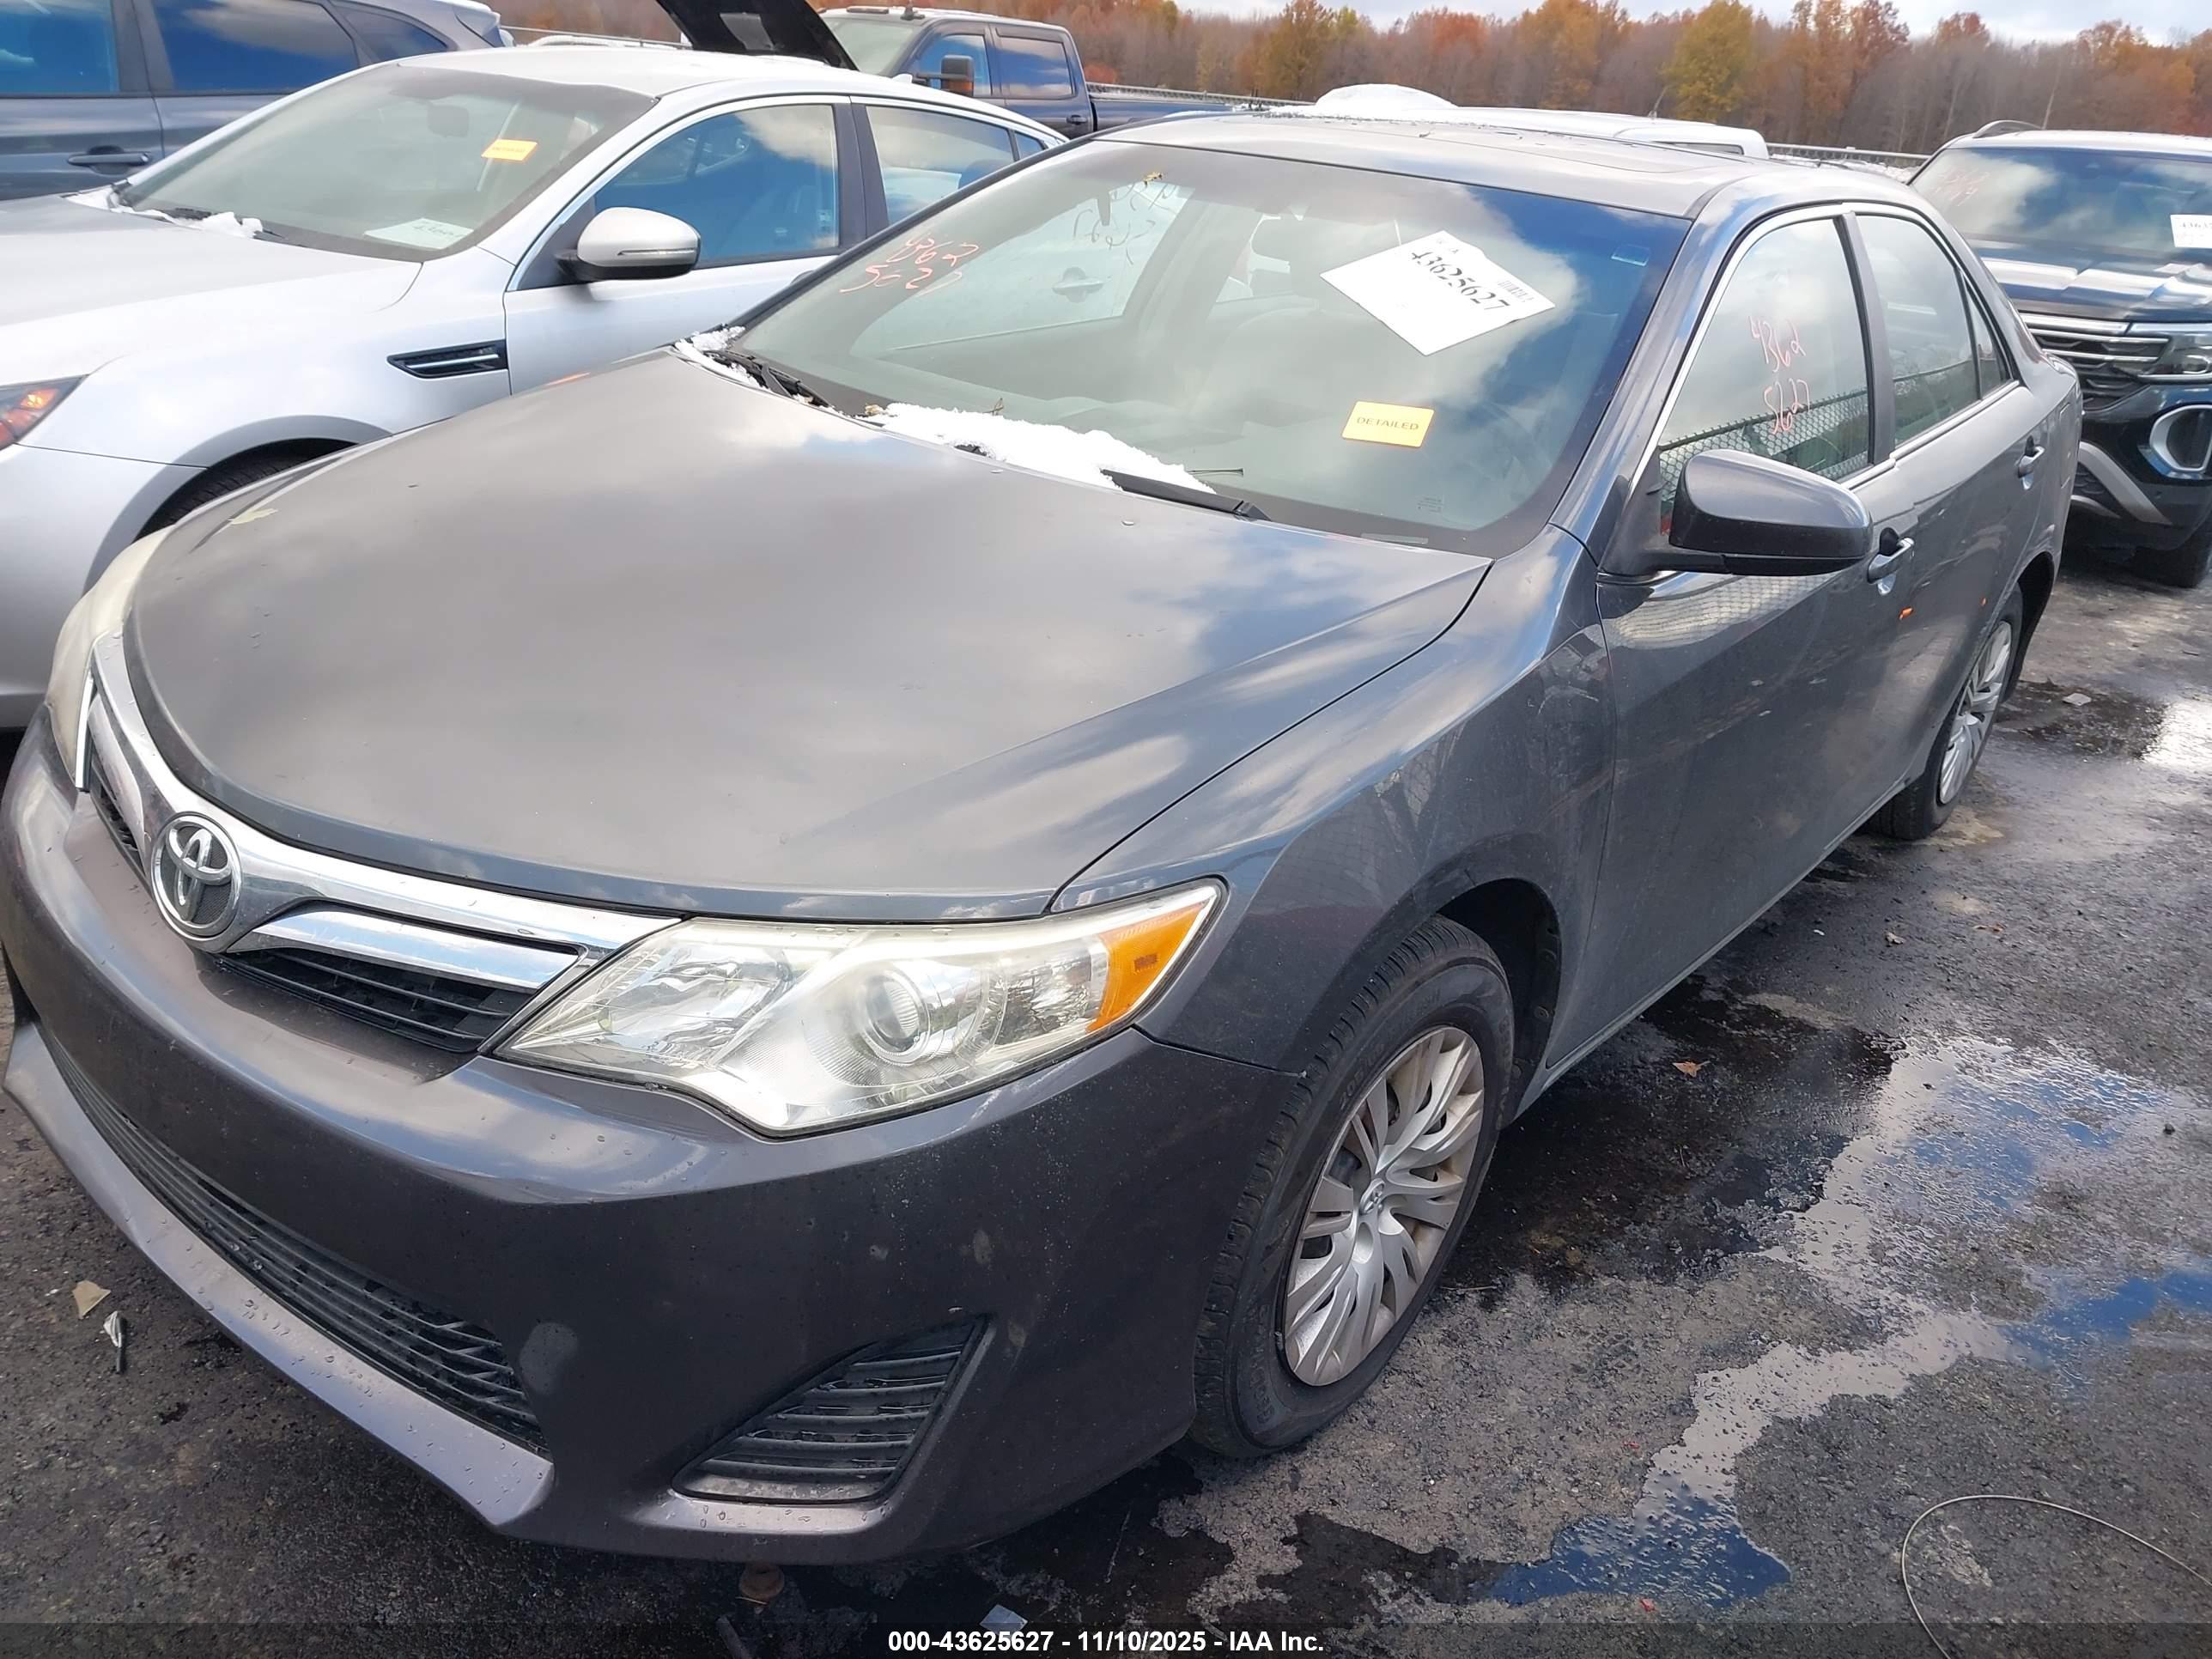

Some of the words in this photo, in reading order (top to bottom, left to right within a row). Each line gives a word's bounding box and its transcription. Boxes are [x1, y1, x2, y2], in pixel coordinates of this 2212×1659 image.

[1411, 251, 1511, 311] 43625627
[1356, 416, 1420, 431] DETAILED
[1764, 377, 1811, 434] 5627
